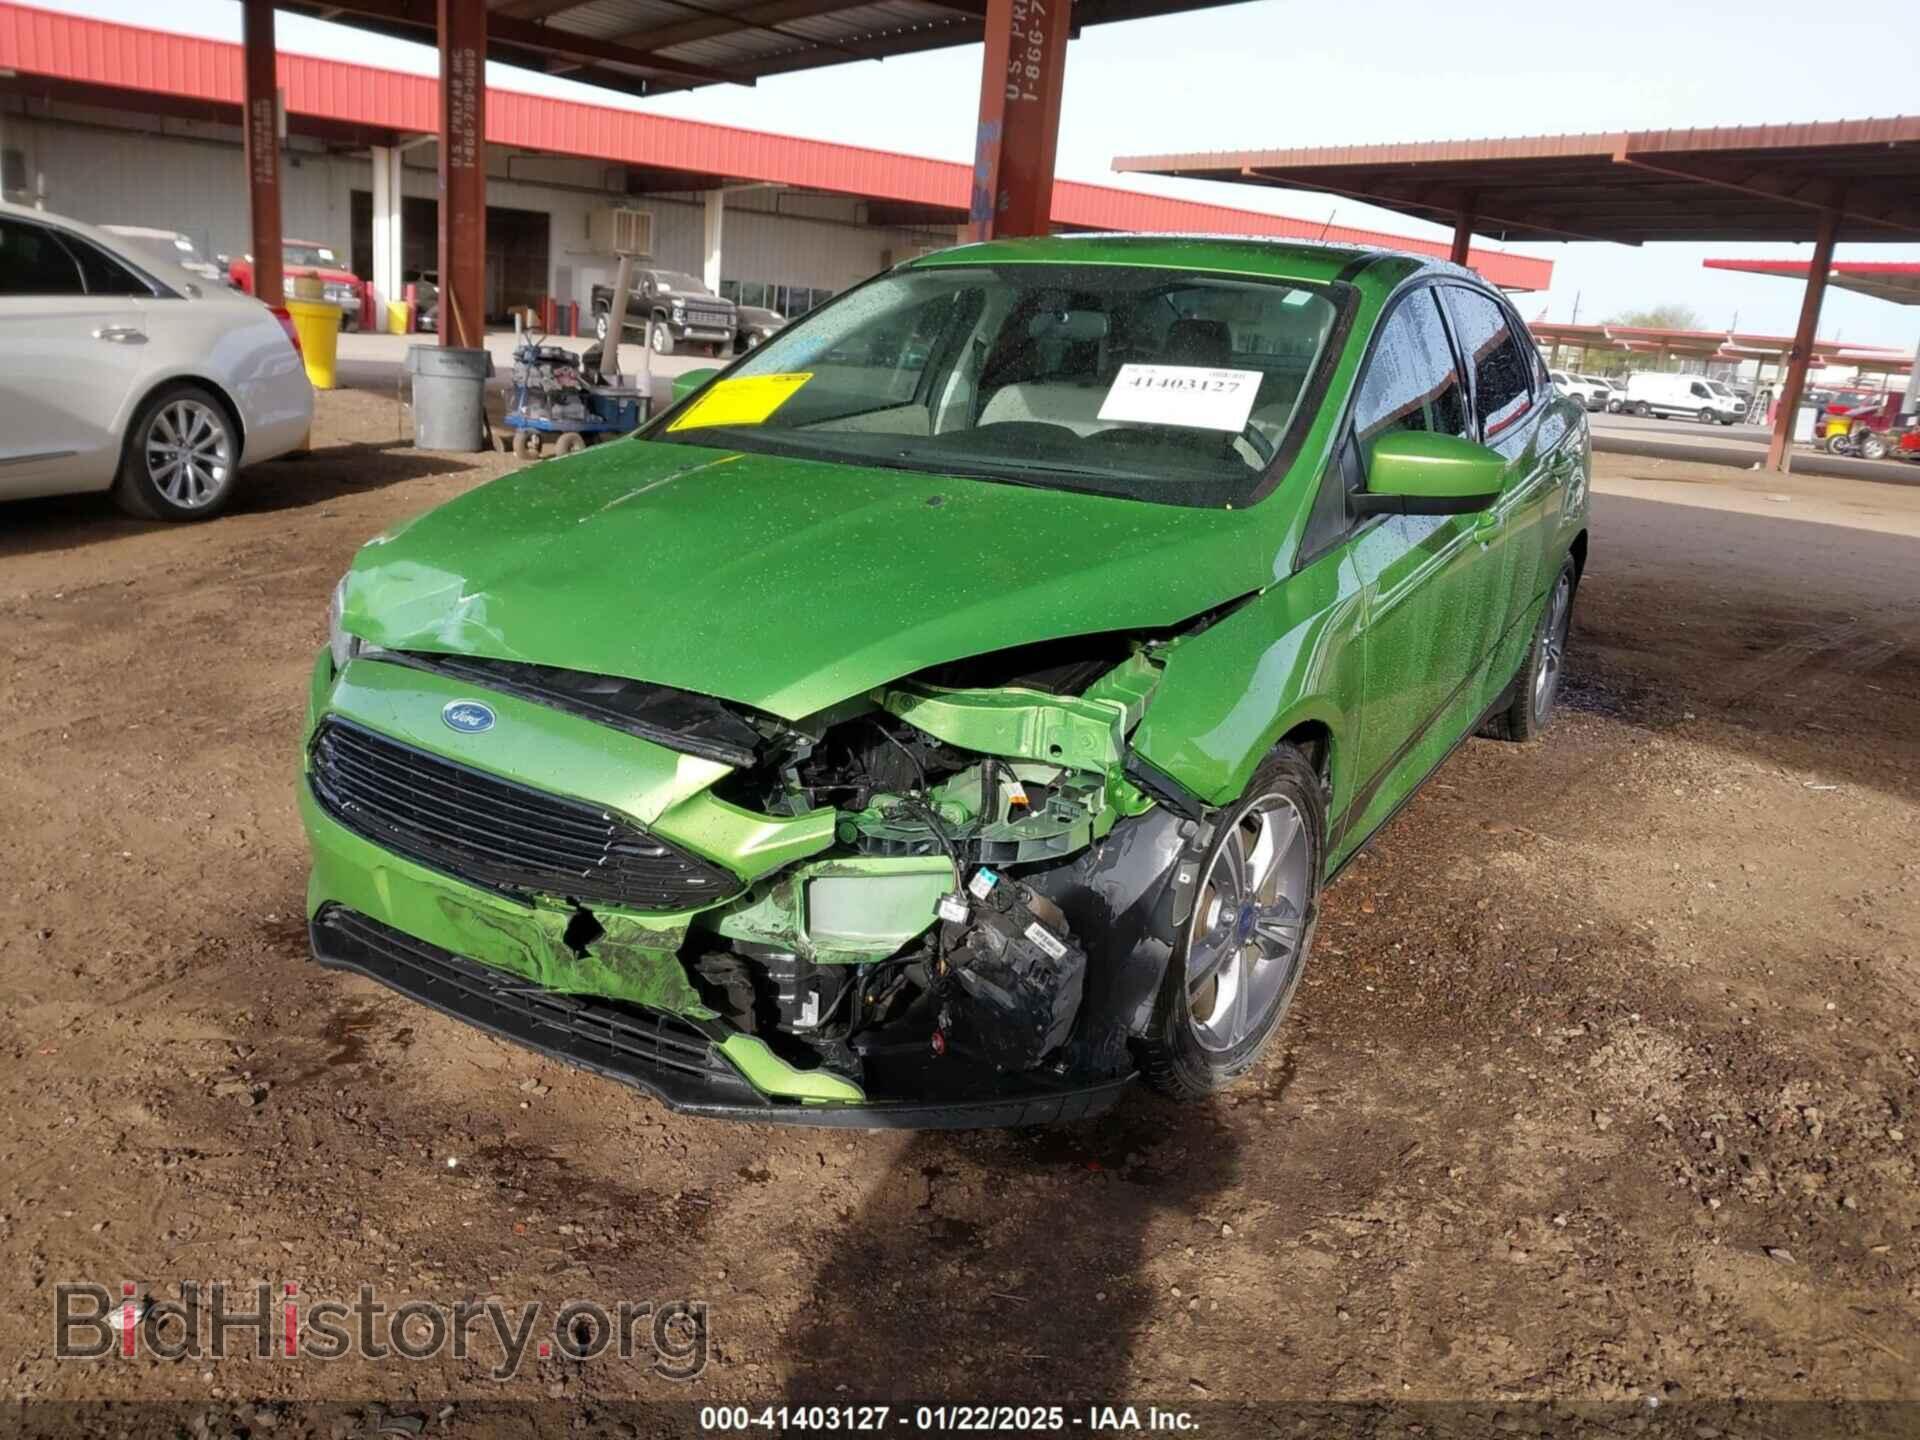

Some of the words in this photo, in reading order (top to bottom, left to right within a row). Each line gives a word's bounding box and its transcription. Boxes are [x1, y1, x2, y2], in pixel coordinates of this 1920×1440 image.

[1011, 0, 1027, 38] PR
[1006, 53, 1023, 100] U.S.
[1129, 377, 1241, 393] 41403127
[451, 709, 485, 726] Ford
